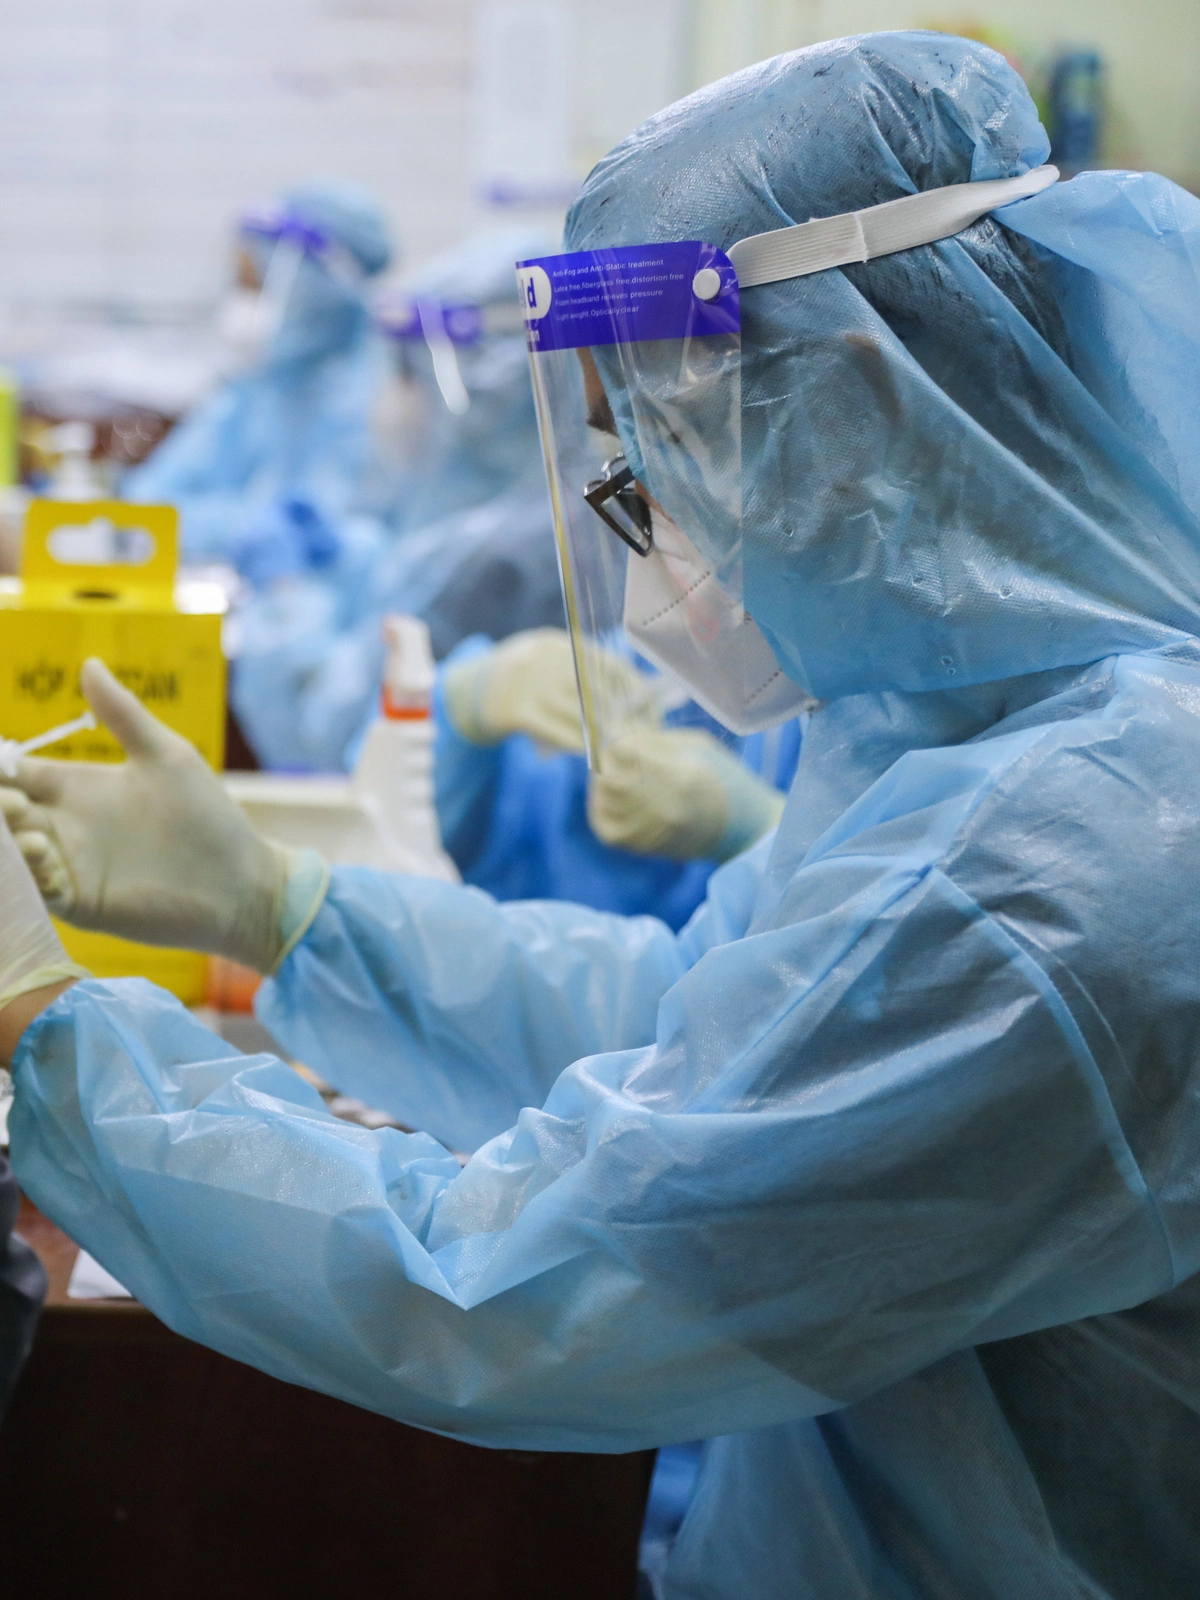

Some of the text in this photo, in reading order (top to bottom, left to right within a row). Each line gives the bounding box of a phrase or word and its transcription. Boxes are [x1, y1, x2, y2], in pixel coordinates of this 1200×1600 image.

[576, 266, 589, 275] and
[590, 262, 627, 273] Anti-Static
[627, 259, 664, 269] treatment
[669, 272, 685, 281] free
[630, 289, 664, 300] pressure
[620, 306, 640, 314] clear
